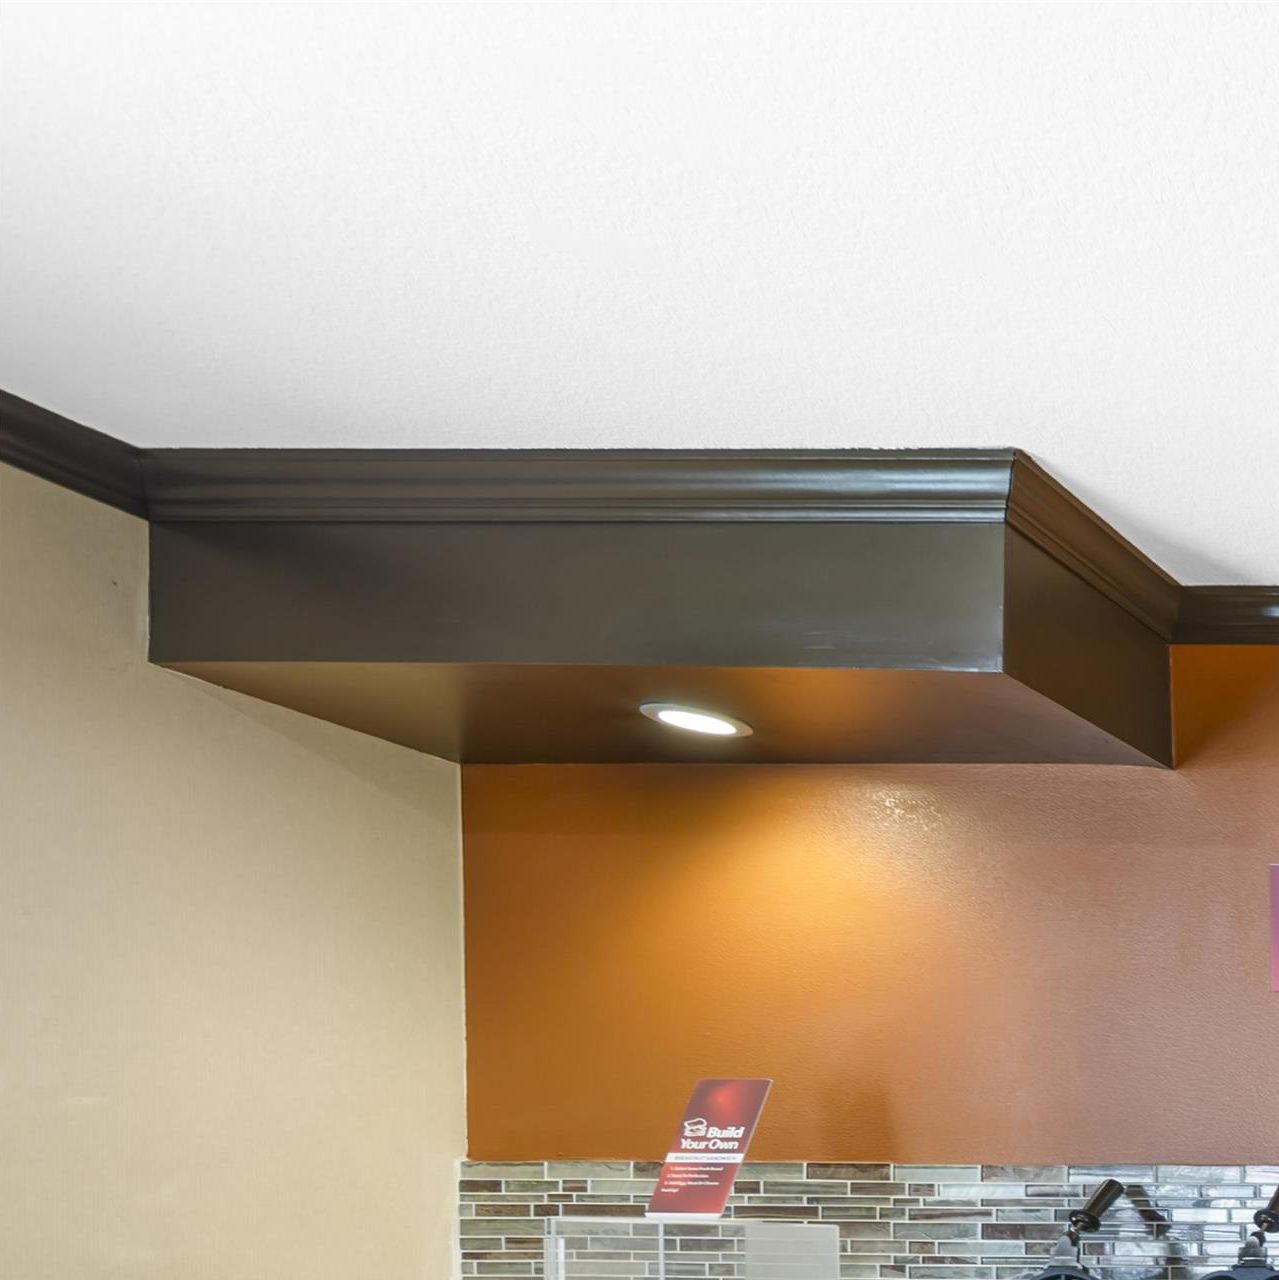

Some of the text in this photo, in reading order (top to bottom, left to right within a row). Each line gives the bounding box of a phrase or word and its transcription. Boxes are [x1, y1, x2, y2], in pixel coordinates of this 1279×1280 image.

[706, 1127, 744, 1138] Build
[681, 1139, 738, 1150] Your Own
